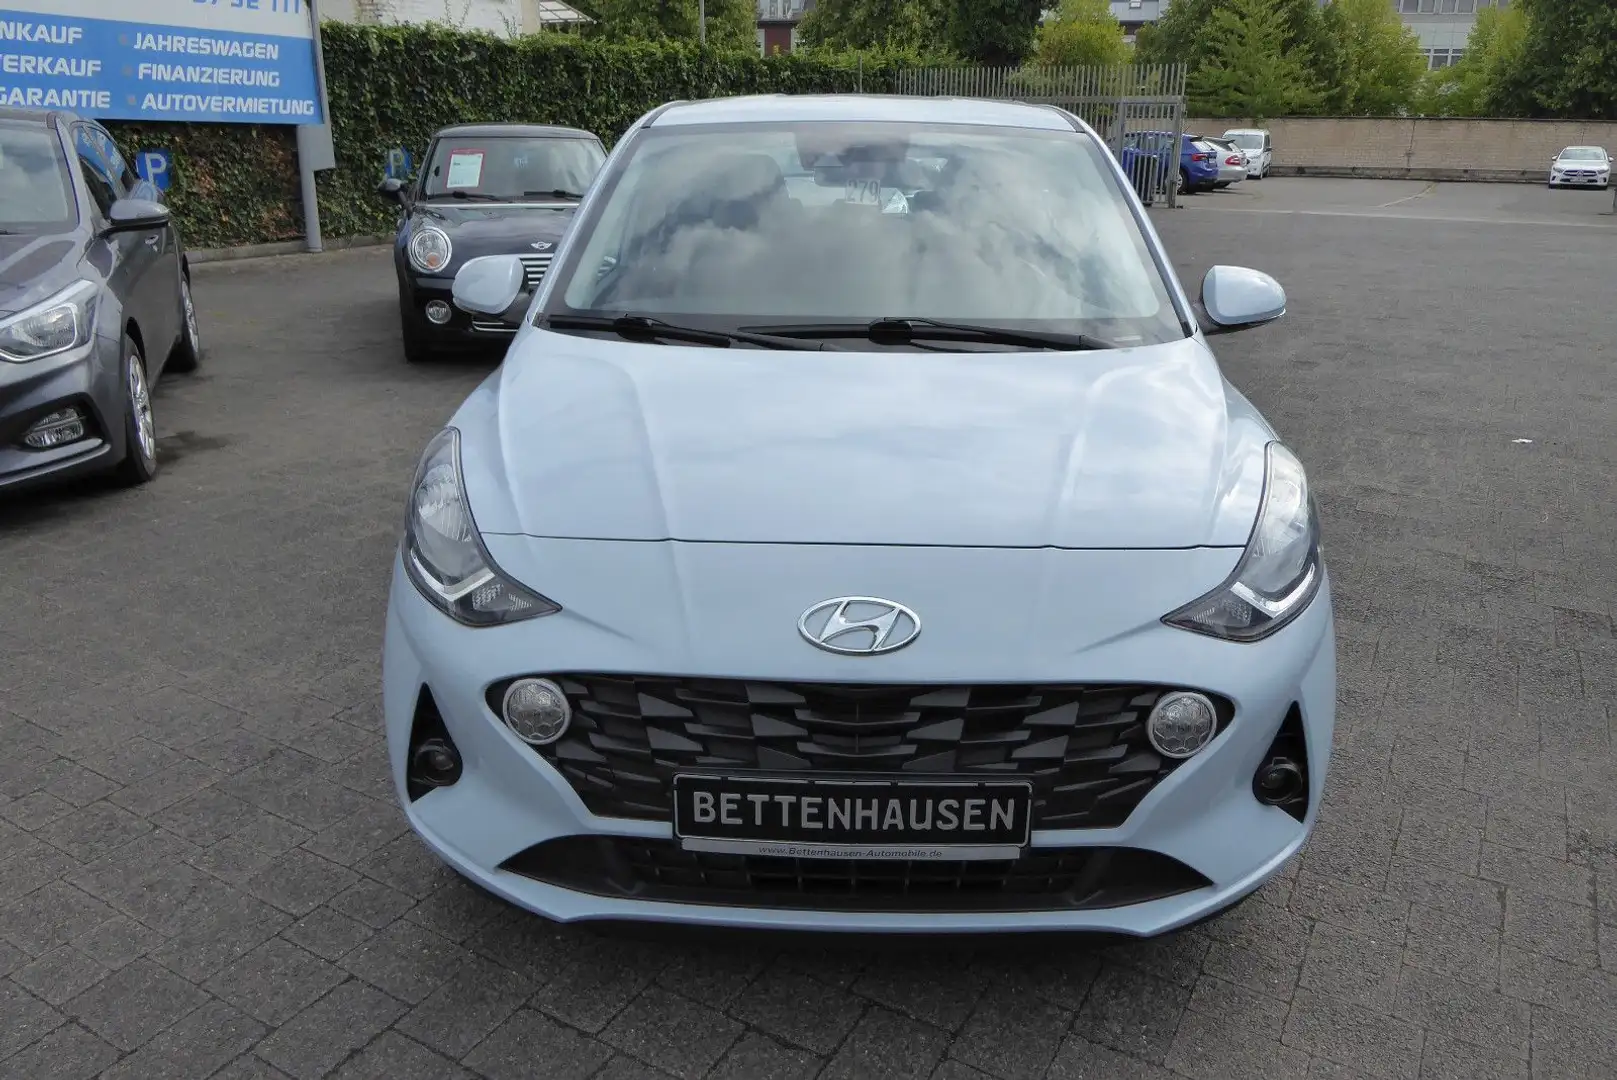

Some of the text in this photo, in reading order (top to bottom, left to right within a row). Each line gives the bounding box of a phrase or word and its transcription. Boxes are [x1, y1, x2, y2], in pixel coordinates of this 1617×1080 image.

[133, 32, 279, 61] JAHRESWAGEN
[0, 53, 102, 77] ERKAUF
[138, 63, 280, 87] FINANZIERUNG
[141, 93, 315, 115] AUTOVERMIETUNG
[144, 152, 167, 186] P
[846, 179, 879, 204] 279
[692, 791, 1015, 831] BETTENHAUSEN
[758, 846, 943, 859] www.Bettenhausen-Automobile.de
